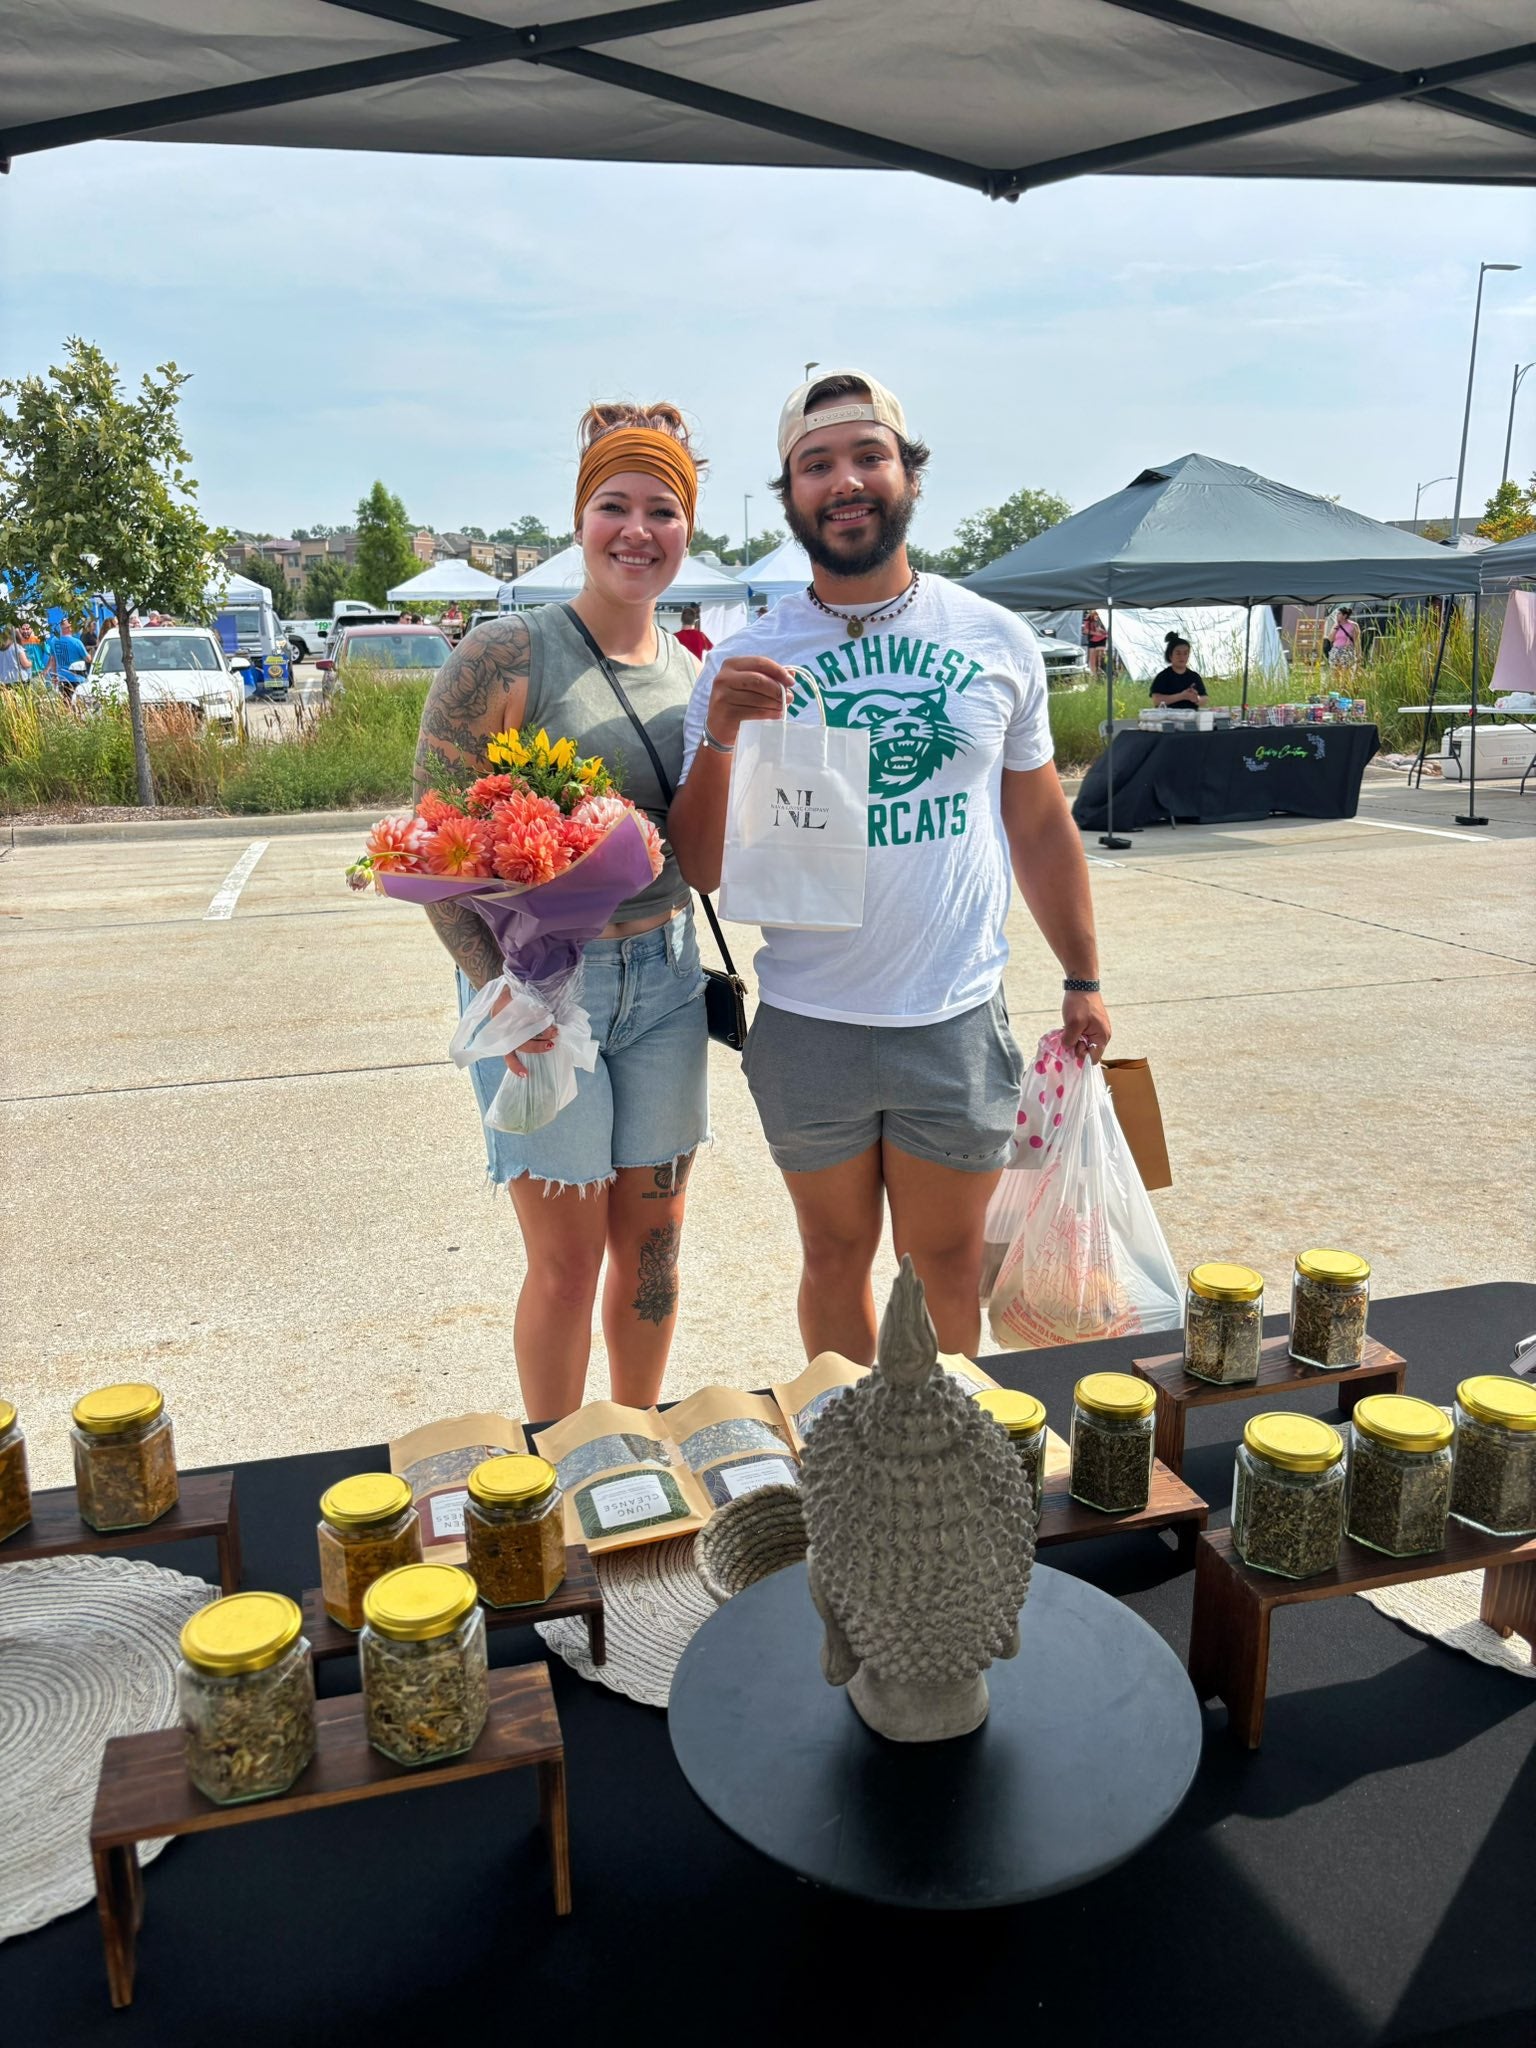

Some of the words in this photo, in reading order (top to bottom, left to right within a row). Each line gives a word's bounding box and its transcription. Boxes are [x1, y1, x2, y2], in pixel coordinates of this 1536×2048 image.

[772, 788, 827, 829] NL
[868, 792, 968, 847] RCATS
[604, 1493, 660, 1512] CLEANSE
[617, 1503, 651, 1517] LUNG
[436, 1513, 464, 1522] NESS
[444, 1520, 465, 1528] DEN
